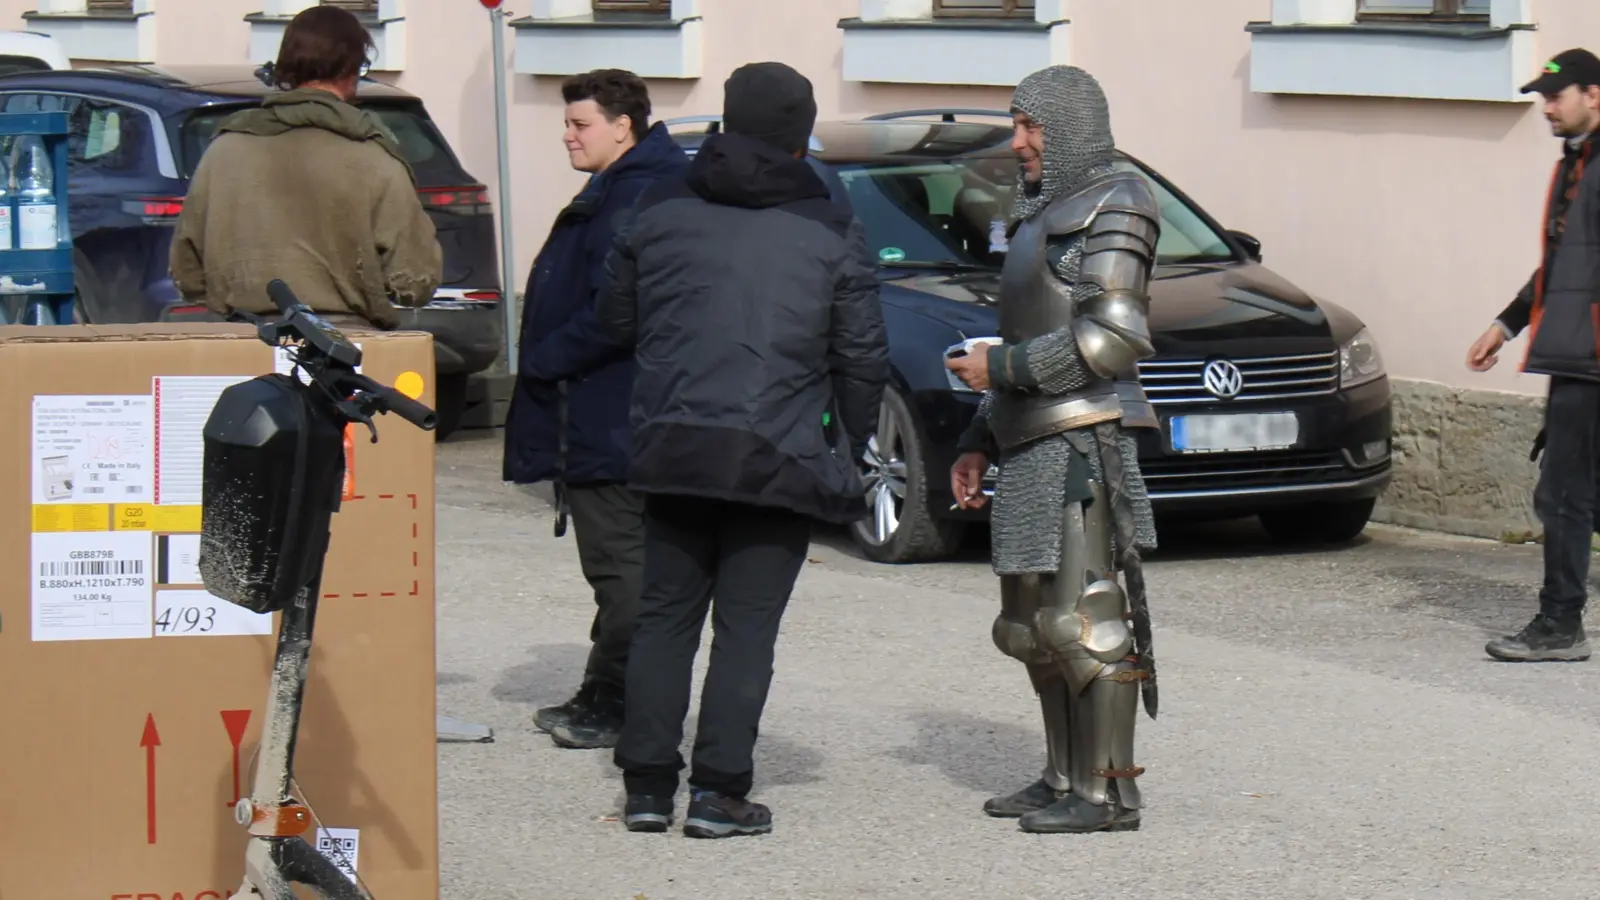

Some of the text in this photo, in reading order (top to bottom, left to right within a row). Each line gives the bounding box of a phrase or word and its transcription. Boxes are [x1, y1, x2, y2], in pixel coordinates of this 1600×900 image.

[126, 462, 141, 470] Italy
[125, 507, 143, 517] G20
[69, 550, 114, 559] GBB879B
[40, 577, 144, 589] B.880xH.1210xT.790
[101, 593, 112, 602] Kg
[155, 606, 217, 632] 4/93
